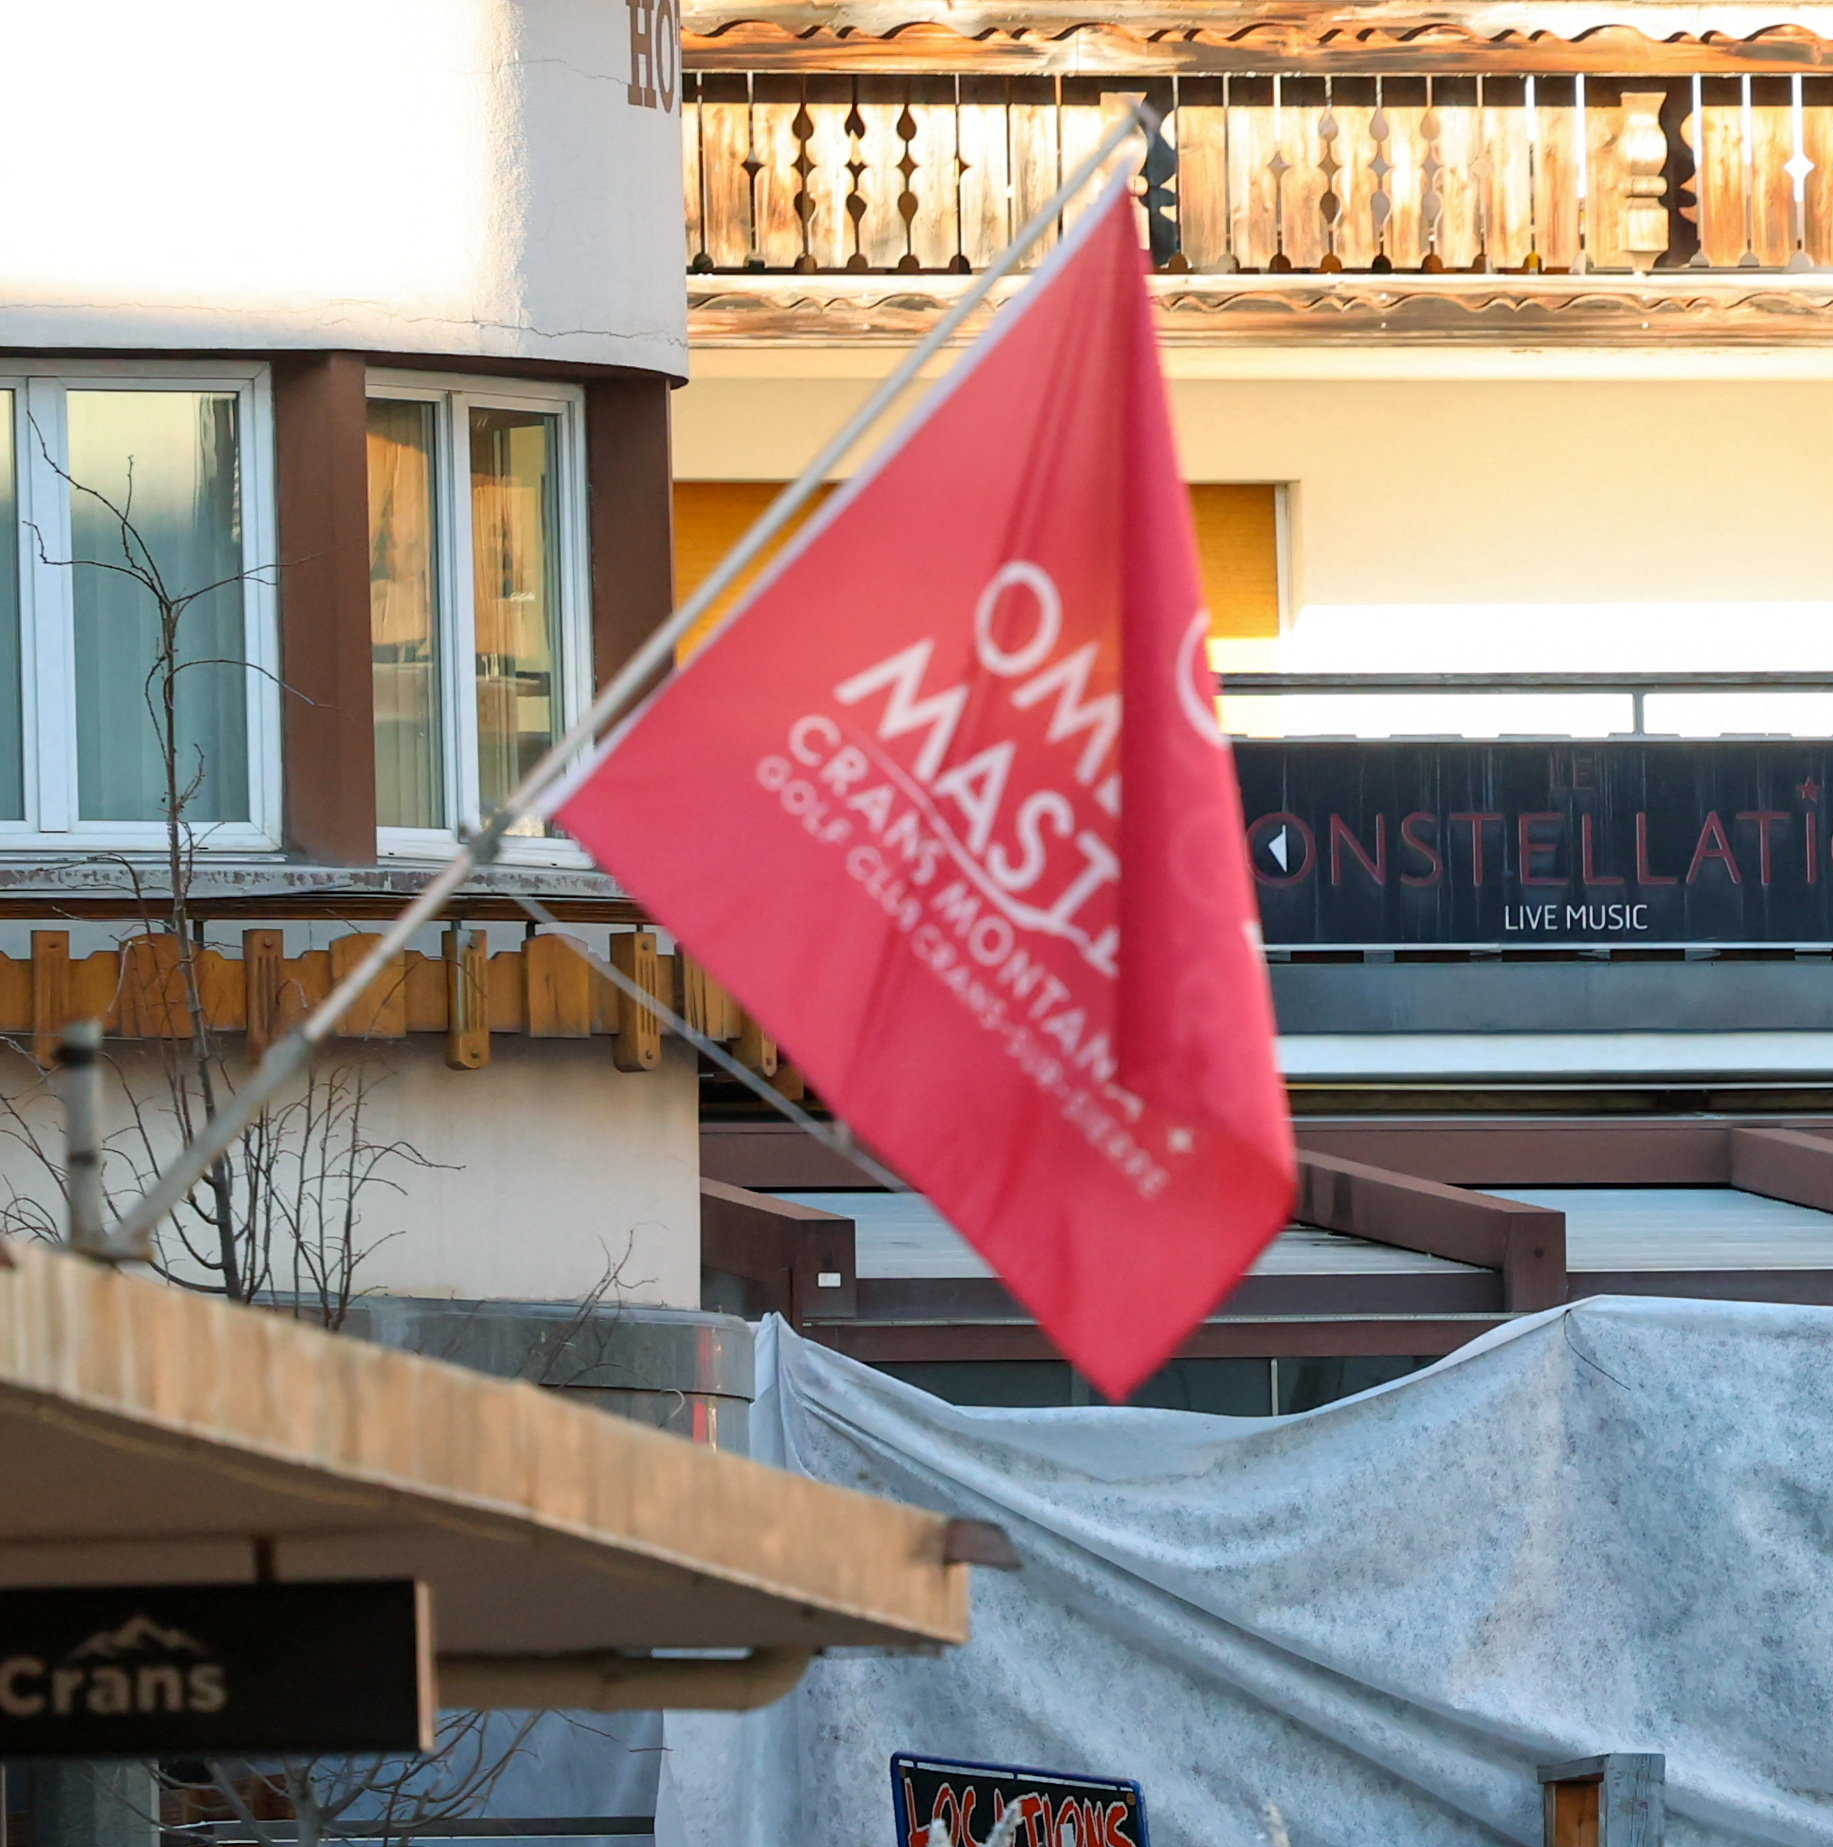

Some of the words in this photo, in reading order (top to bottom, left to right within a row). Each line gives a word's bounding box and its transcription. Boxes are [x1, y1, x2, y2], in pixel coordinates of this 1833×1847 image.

[1504, 904, 1559, 931] LIVE
[1566, 904, 1648, 931] MUSIC
[0, 1656, 229, 1717] Crans
